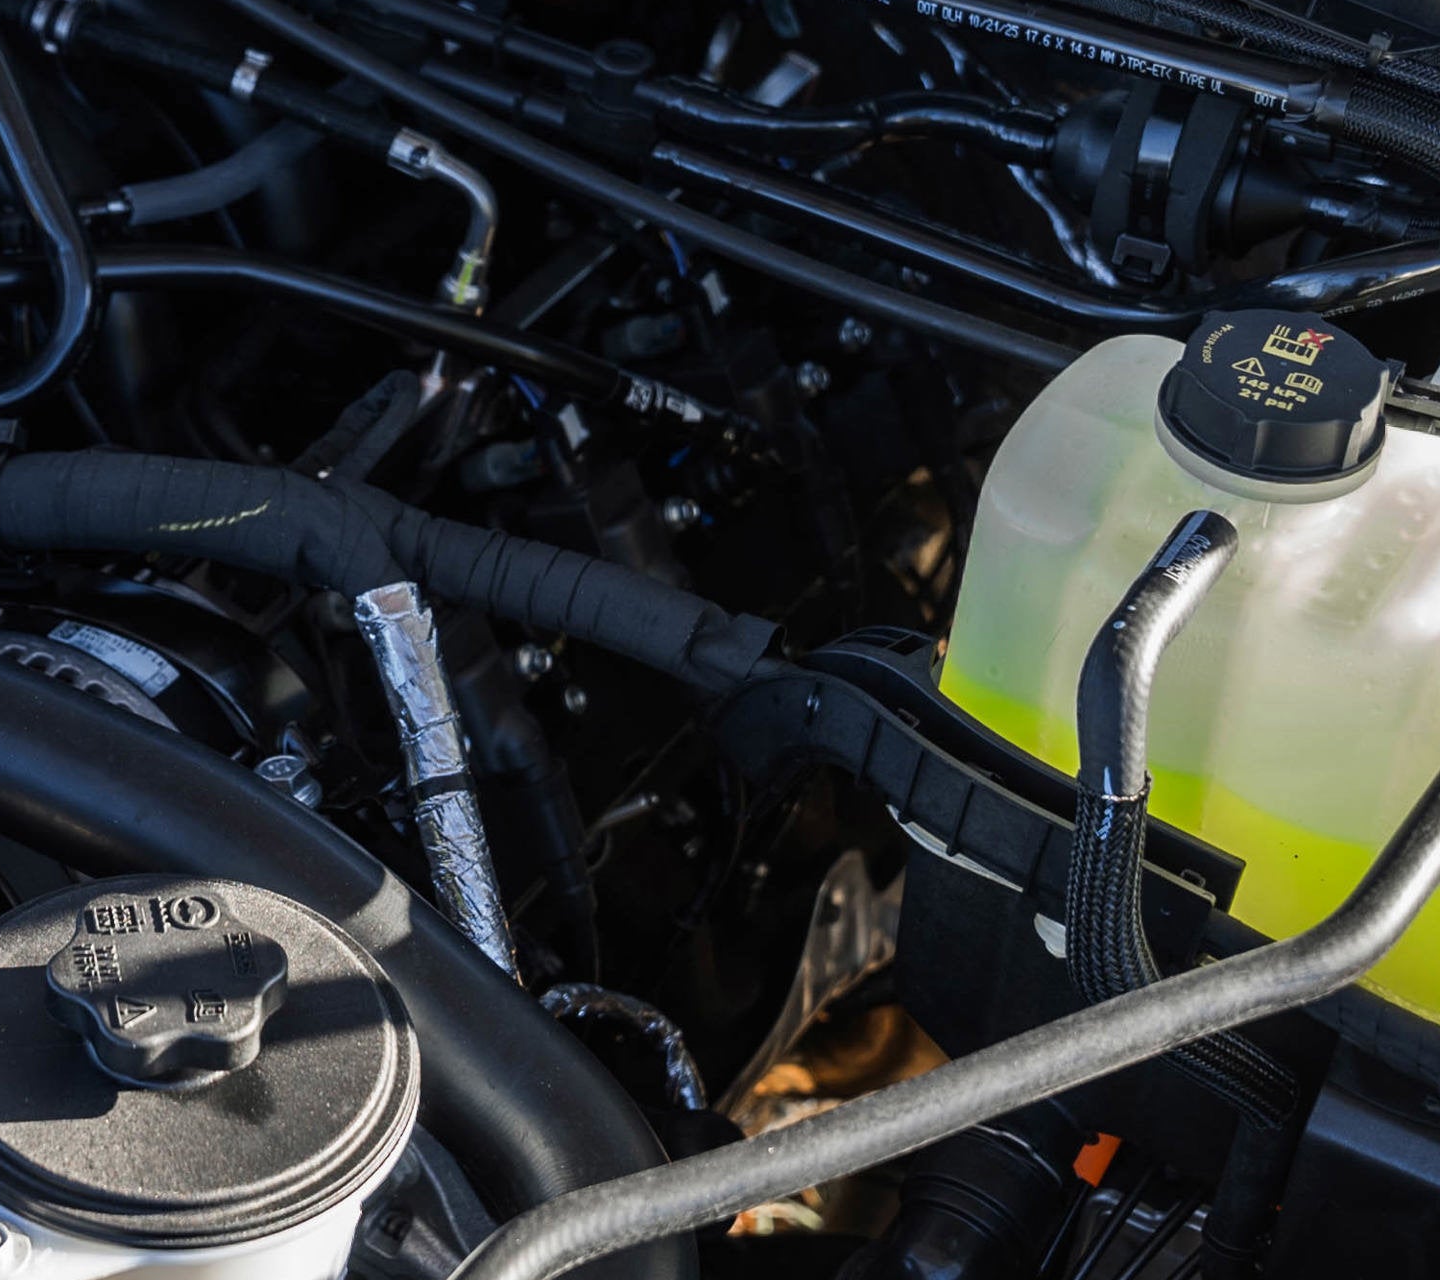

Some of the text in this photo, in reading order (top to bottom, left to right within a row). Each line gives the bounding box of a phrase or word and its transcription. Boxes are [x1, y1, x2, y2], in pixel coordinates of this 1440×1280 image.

[914, 0, 939, 18] DOT
[966, 14, 1021, 39] 10/21/25
[1023, 29, 1052, 48] 17.6
[1054, 37, 1066, 51] X
[1068, 41, 1097, 60] 14.3
[1099, 49, 1116, 65] MM
[1177, 70, 1207, 90] TYPE
[1209, 78, 1226, 95] UL
[1253, 91, 1278, 110] DOT
[1237, 375, 1308, 403] 145 kPa
[1238, 388, 1295, 411] 21 psi
